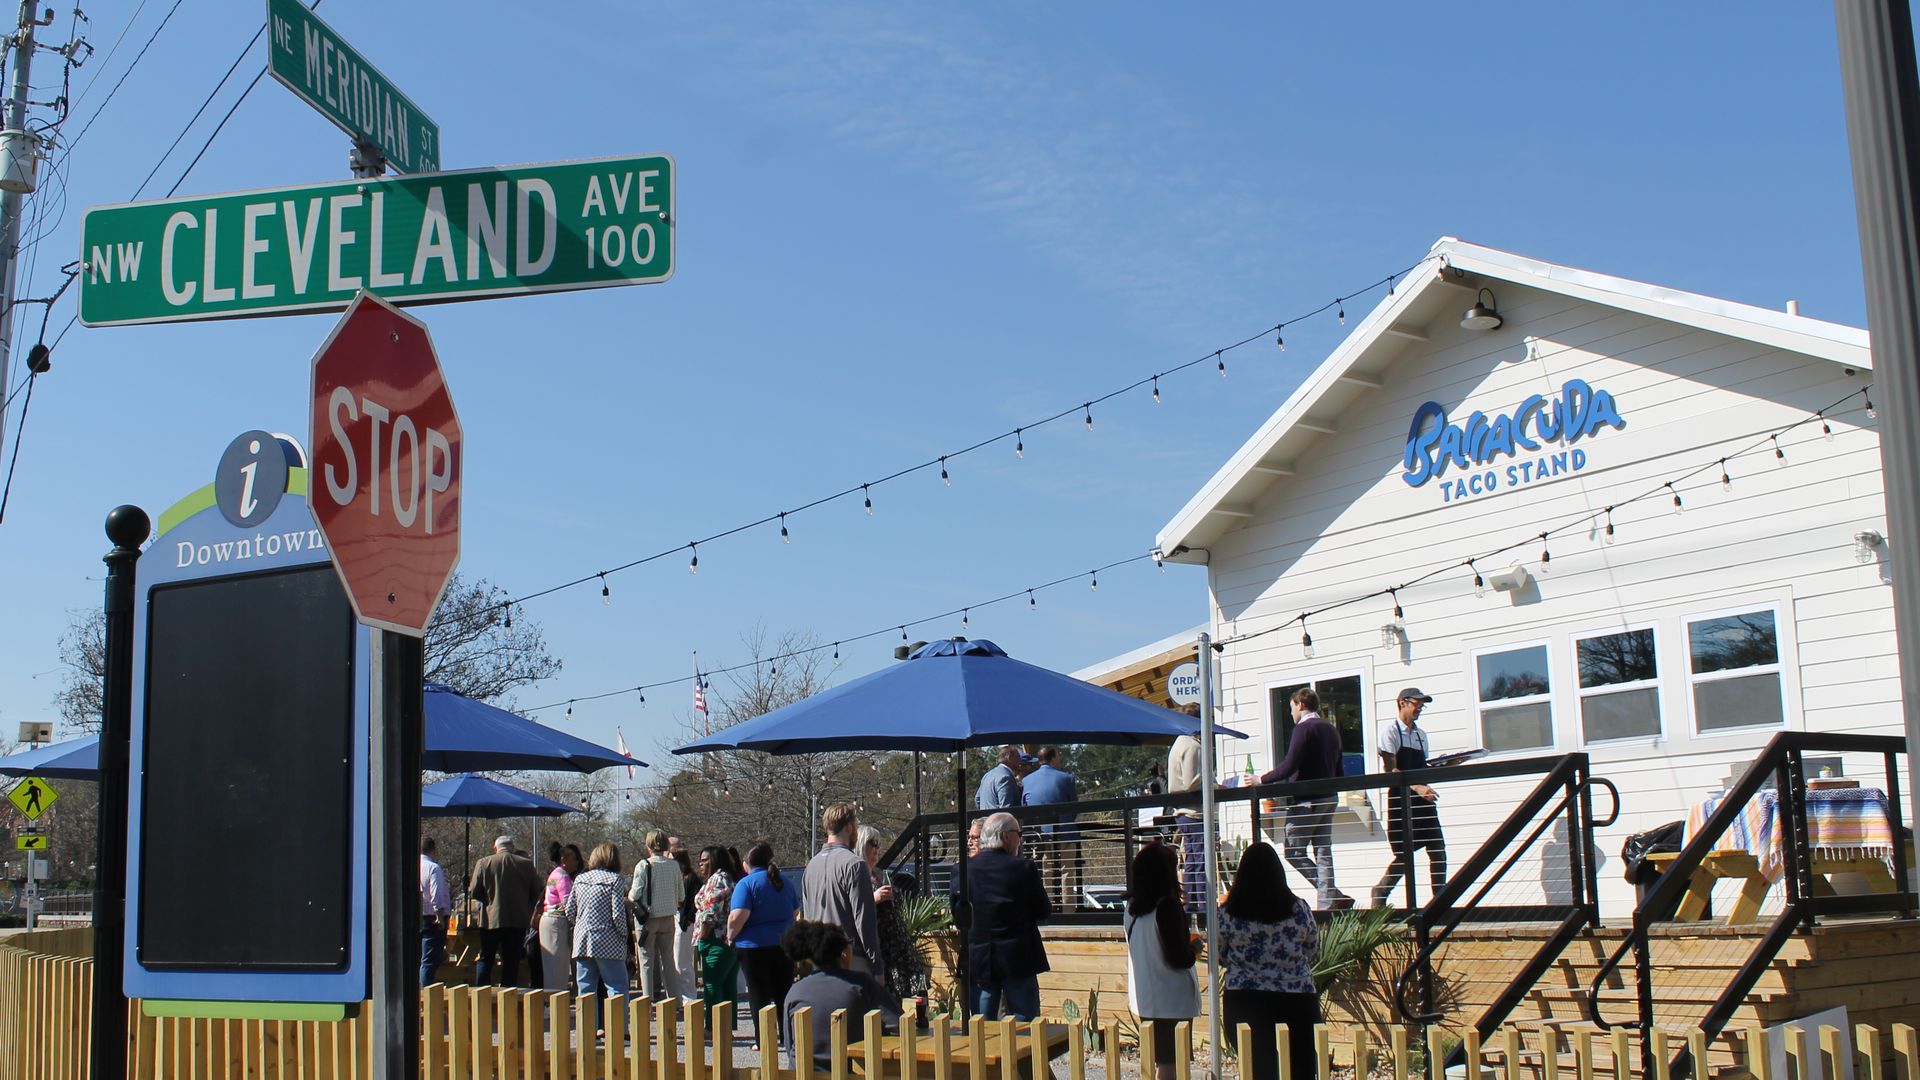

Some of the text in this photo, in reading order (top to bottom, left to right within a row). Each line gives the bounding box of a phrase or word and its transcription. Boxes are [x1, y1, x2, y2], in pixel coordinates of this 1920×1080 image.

[274, 14, 432, 168] NE MERIDIAN ST
[91, 170, 660, 306] NW CLEVELAND AVE
[586, 223, 656, 269] 100
[324, 386, 452, 535] STOP
[1440, 448, 1587, 501] TACO STAND
[176, 528, 324, 568] Downtown
[1176, 686, 1200, 696] HER
